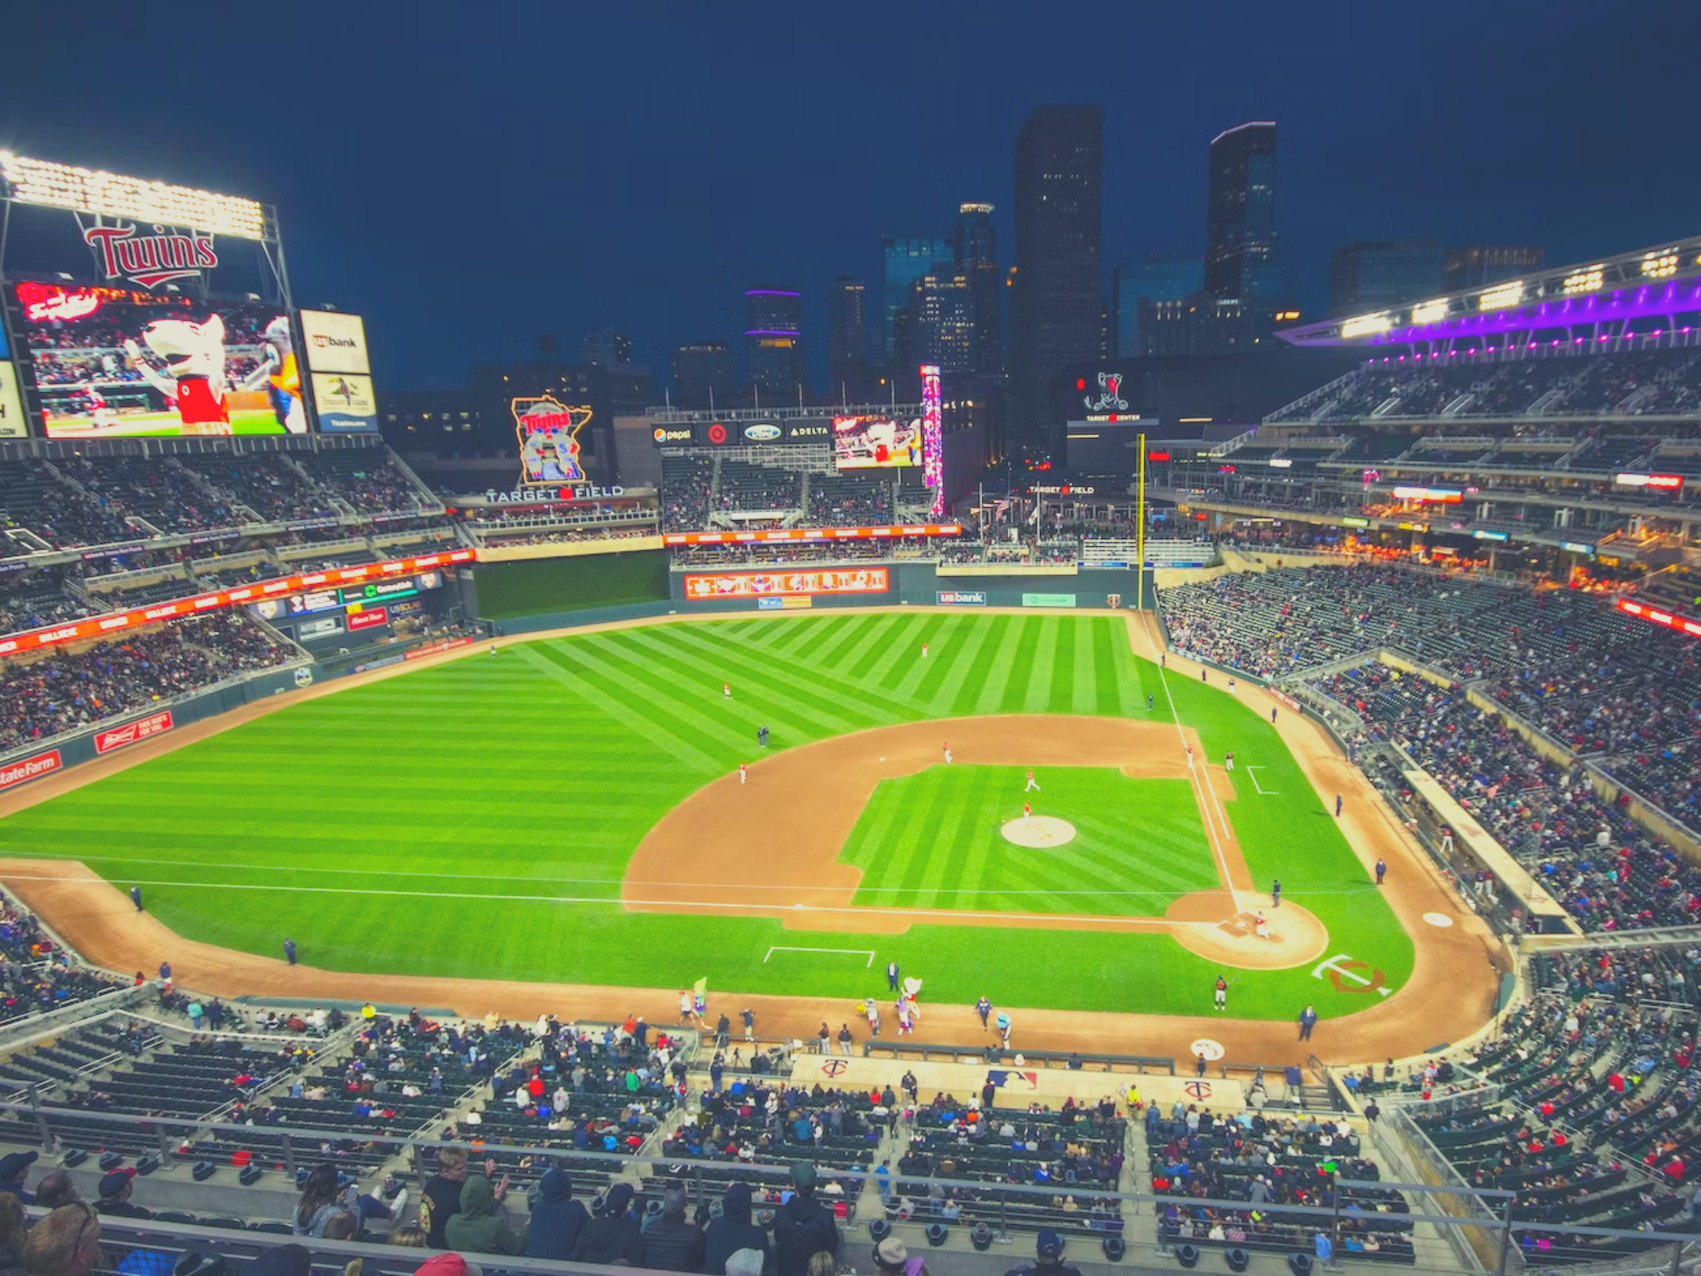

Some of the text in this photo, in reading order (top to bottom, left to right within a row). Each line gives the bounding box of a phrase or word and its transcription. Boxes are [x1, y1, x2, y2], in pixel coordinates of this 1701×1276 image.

[84, 223, 218, 280] Twins
[520, 411, 571, 434] Twins
[666, 429, 692, 441] pepsi
[799, 427, 829, 436] DELTA
[486, 486, 624, 503] TARGET FIELD
[1029, 486, 1095, 494] TARGET FIELD
[940, 592, 983, 604] usbank
[0, 757, 55, 785] tate Farm
